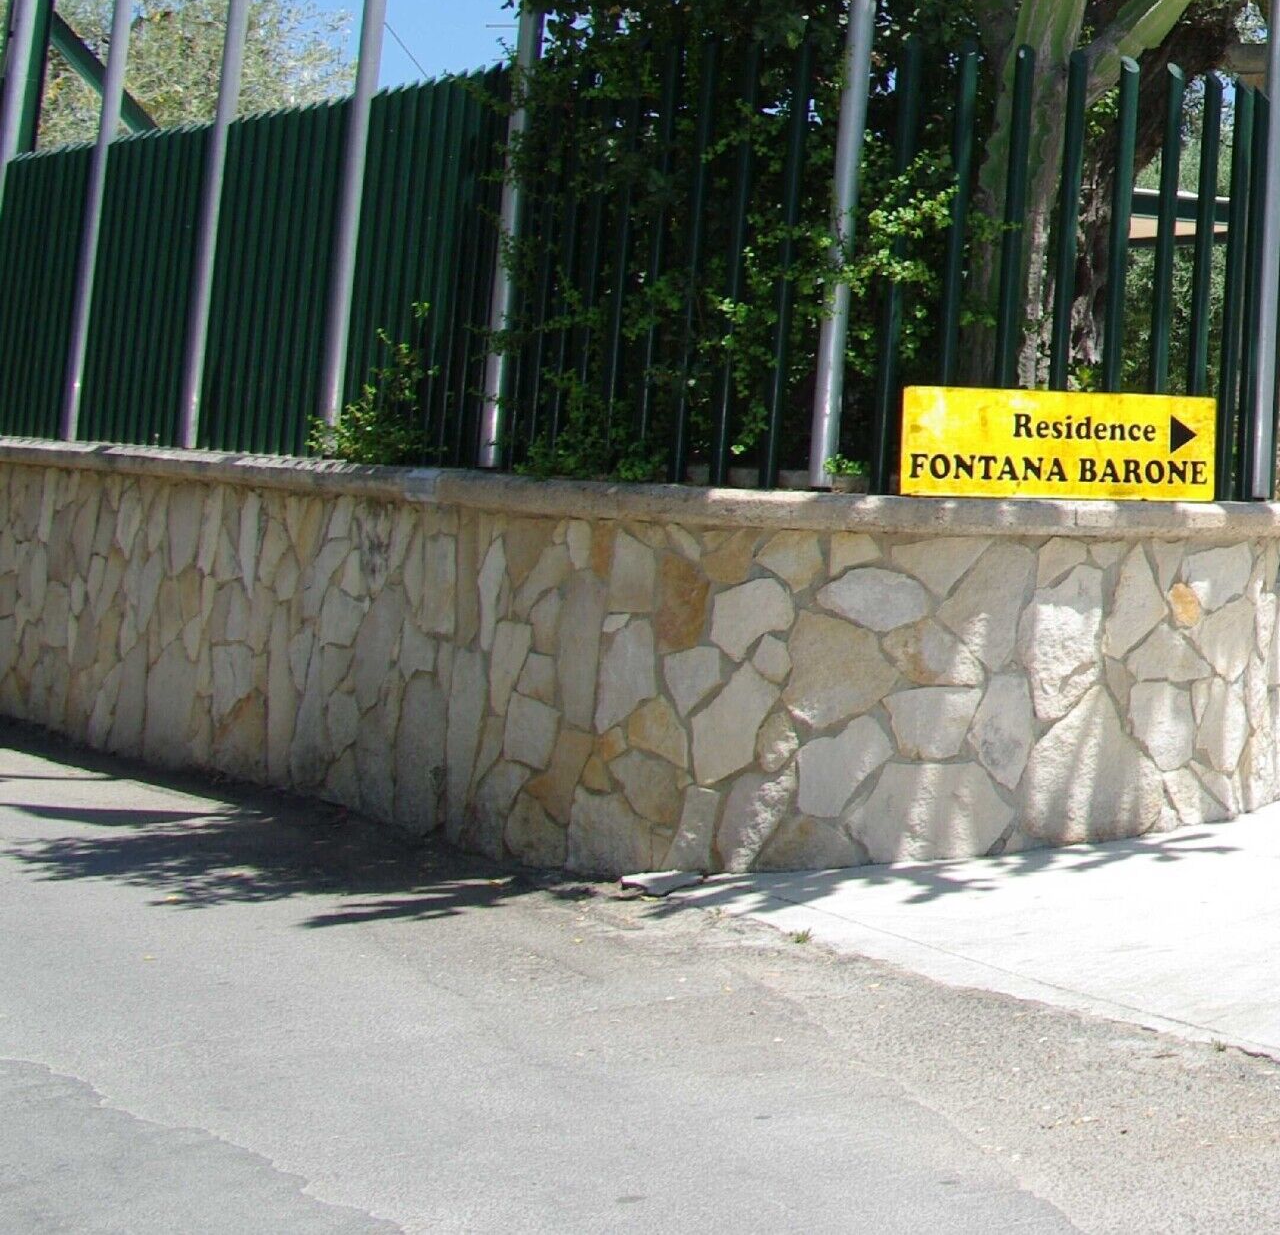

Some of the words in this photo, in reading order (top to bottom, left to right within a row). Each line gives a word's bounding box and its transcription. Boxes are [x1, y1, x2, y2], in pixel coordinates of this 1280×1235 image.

[1012, 413, 1156, 442] Residence
[909, 453, 1068, 483] FONTANA
[1078, 458, 1208, 485] BARONE
